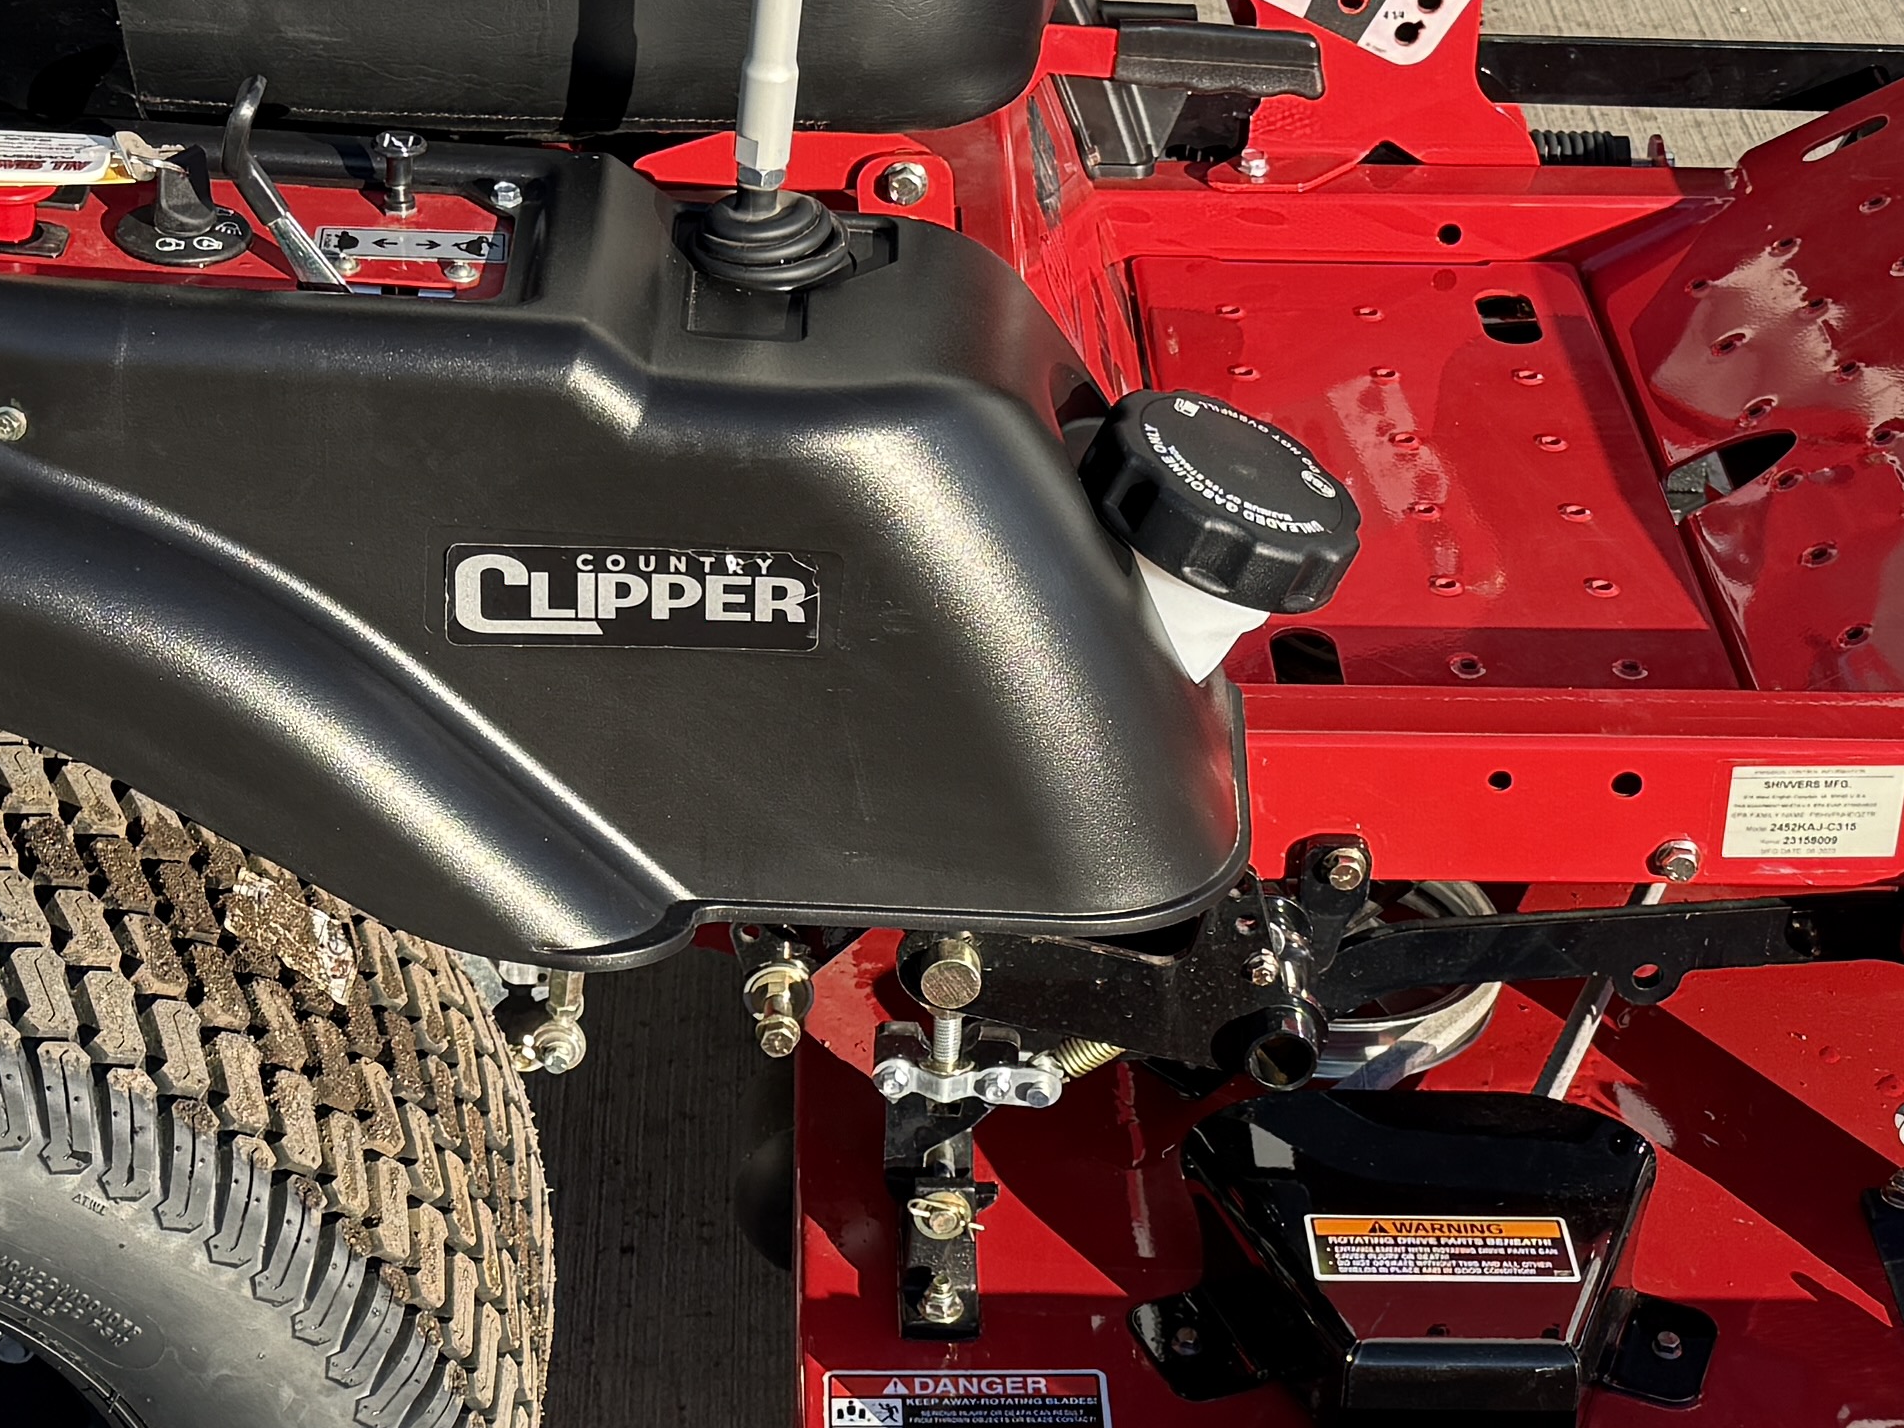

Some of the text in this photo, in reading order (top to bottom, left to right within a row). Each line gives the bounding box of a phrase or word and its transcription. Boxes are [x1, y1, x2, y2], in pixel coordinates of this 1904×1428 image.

[1383, 11, 1405, 20] 4 1/4
[49, 160, 93, 172] ALL
[1197, 400, 1321, 474] DO NOT OVERFILL
[1143, 423, 1325, 535] UNLEADED GASOLINE ONLY
[576, 553, 774, 576] COUNTRY
[454, 553, 806, 636] CLIPPER
[1764, 780, 1820, 789] SHIVVERS
[1770, 822, 1857, 832] 2452KAJ-C315
[1392, 1221, 1504, 1234] WARNING
[1328, 1236, 1395, 1245] ROTATING
[1397, 1236, 1438, 1245] DRIVE
[1440, 1237, 1484, 1246] PARTS
[1502, 1260, 1520, 1268] ALL
[914, 1376, 1048, 1394] DANGER
[906, 1398, 939, 1406] KEEP
[1045, 1397, 1097, 1405] BLADES!
